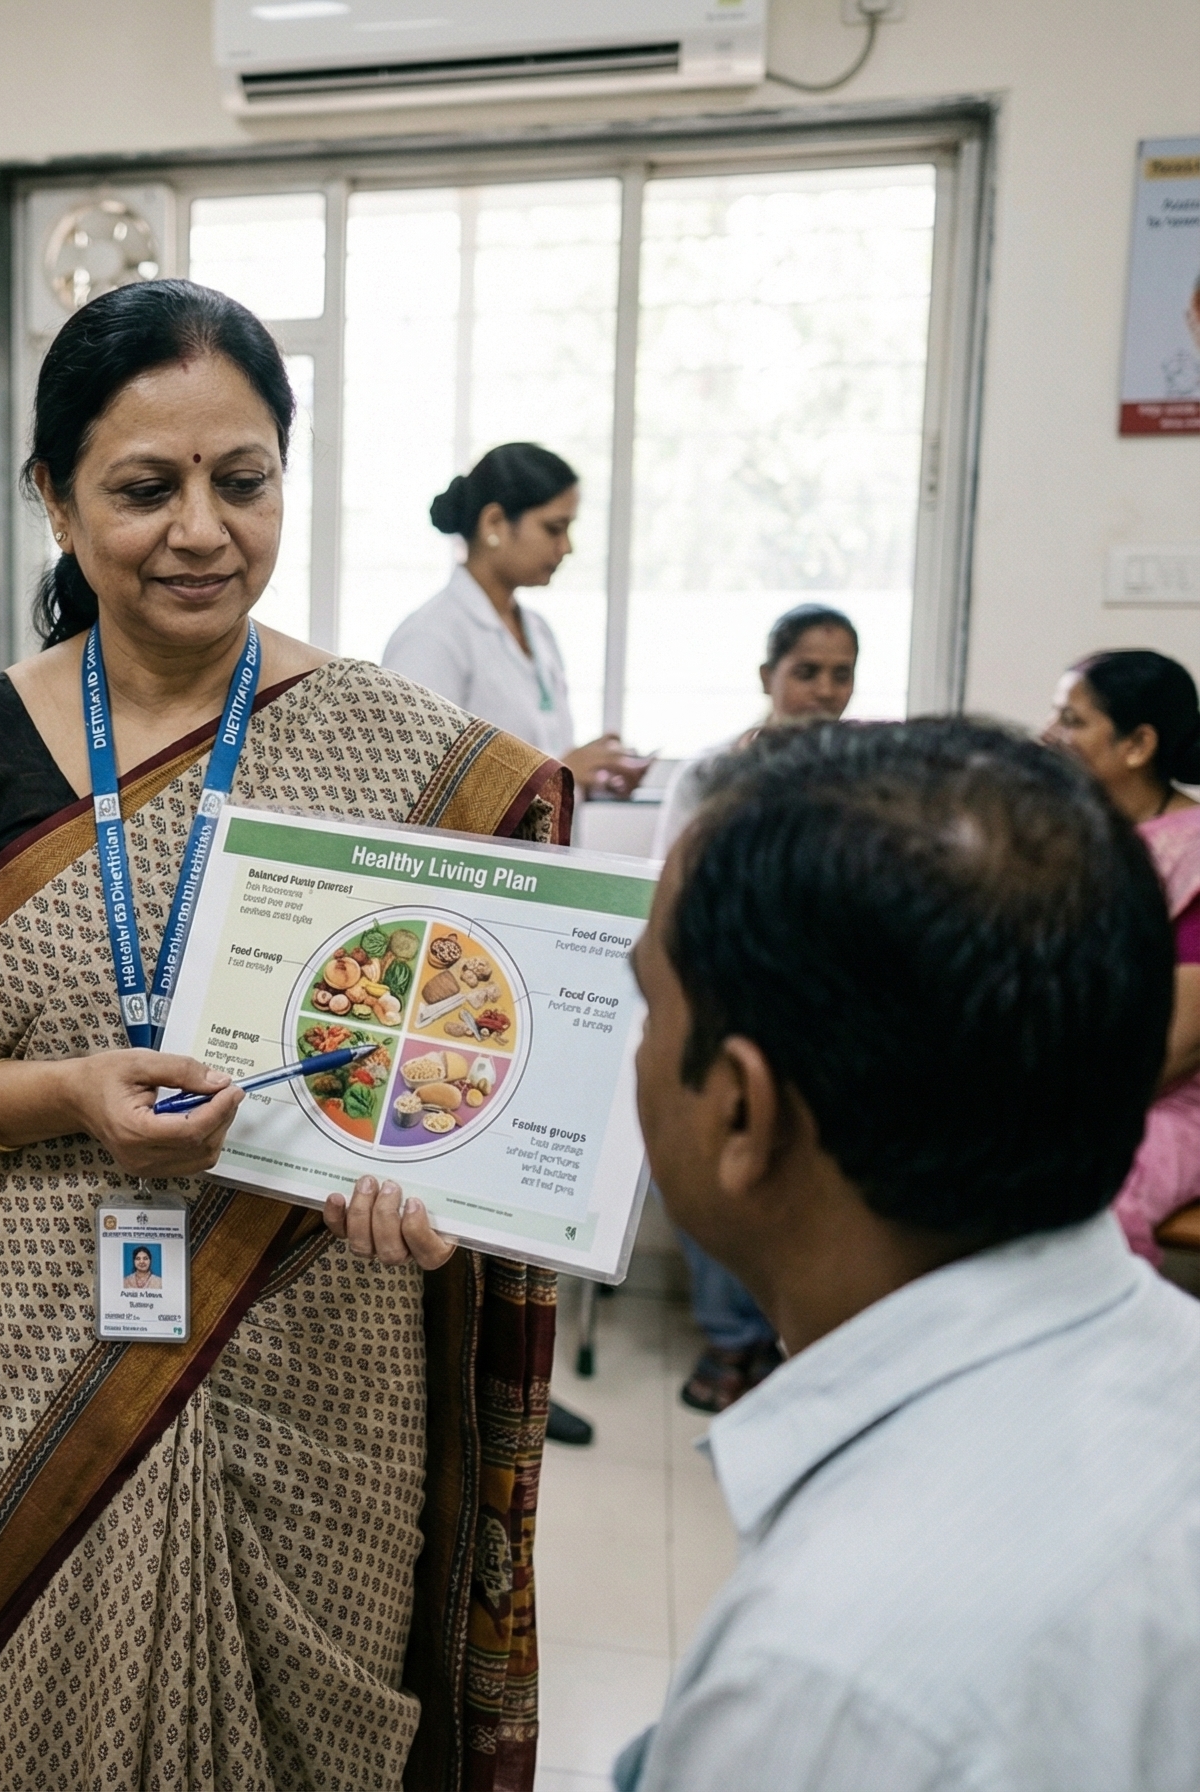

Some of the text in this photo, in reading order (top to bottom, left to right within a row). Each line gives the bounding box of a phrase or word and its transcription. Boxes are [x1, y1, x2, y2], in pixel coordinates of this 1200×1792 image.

[351, 845, 537, 893] Healthy Living Plan
[599, 932, 632, 948] Group
[587, 992, 619, 1008] Group
